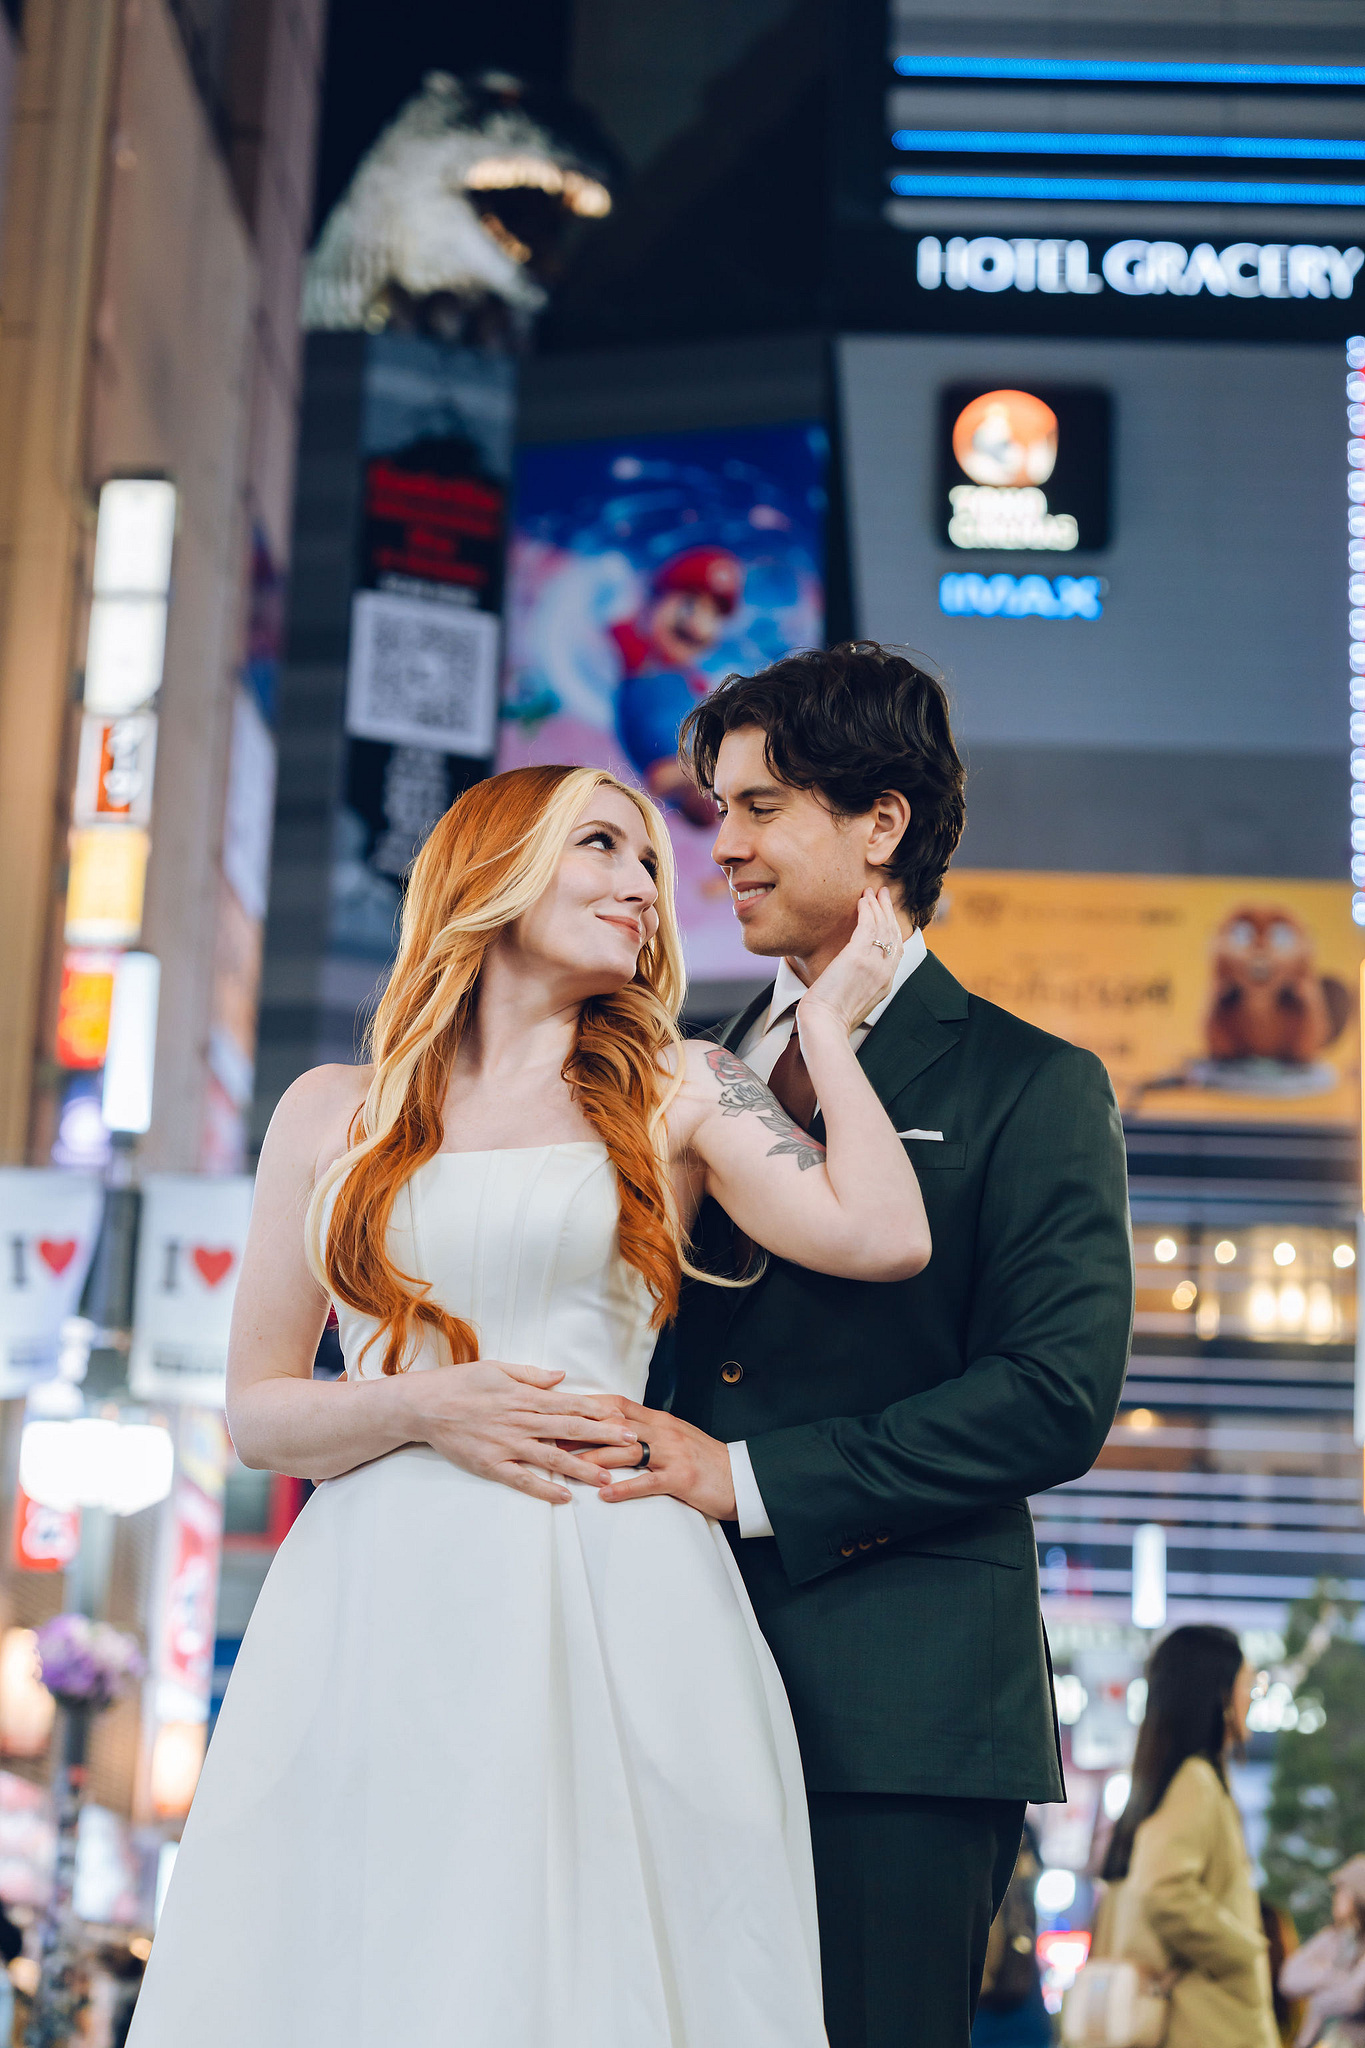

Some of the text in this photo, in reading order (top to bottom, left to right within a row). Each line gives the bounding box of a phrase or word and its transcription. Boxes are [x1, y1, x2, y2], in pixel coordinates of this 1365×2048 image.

[917, 236, 1365, 299] HOTEL GRACERY
[939, 572, 1103, 621] IMAX
